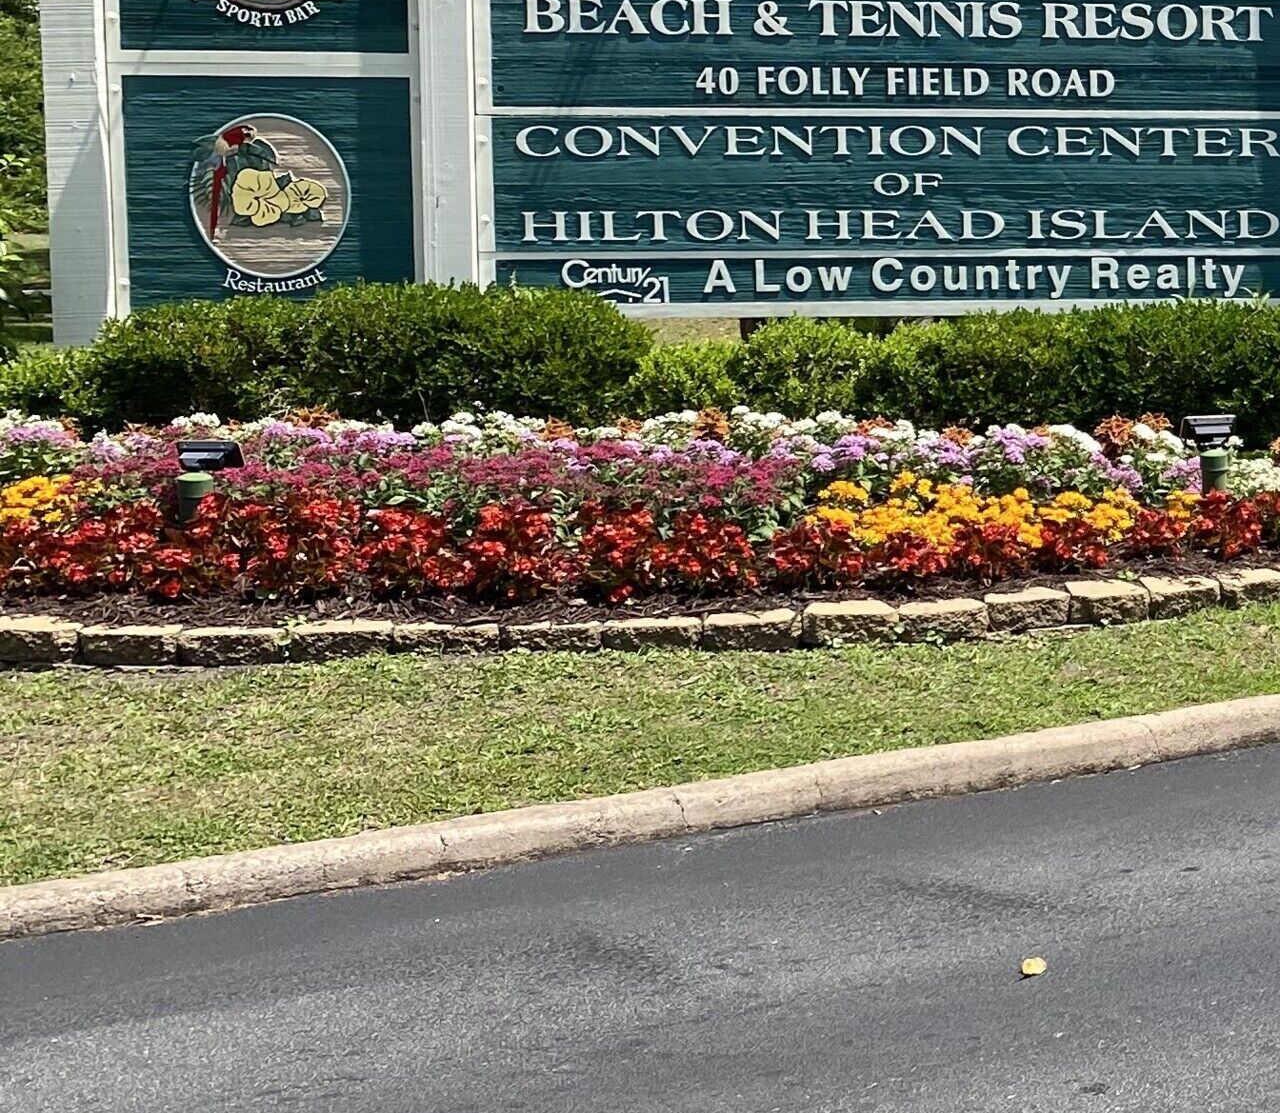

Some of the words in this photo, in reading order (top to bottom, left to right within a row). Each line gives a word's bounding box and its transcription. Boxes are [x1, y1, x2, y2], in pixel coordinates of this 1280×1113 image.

[286, 0, 321, 24] BAR
[753, 0, 794, 37] &
[808, 0, 1023, 39] TENNIS
[1041, 2, 1274, 42] RESORT
[695, 66, 740, 95] 40
[757, 66, 871, 96] FOLLY
[887, 67, 990, 96] FIELD
[1007, 68, 1118, 97] ROAD
[515, 125, 984, 158] CONVENTION
[1007, 126, 1280, 158] CENTER
[873, 172, 944, 196] OF
[521, 209, 784, 242] HILTON
[805, 209, 1005, 241] HEAD
[1026, 209, 1280, 241] ISLAND
[222, 268, 328, 293] Restaurant
[561, 259, 651, 288] Century
[642, 276, 671, 304] 21
[703, 259, 737, 294] A
[754, 259, 853, 293] Low
[871, 257, 1073, 300] Country
[1090, 256, 1246, 299] Realty
